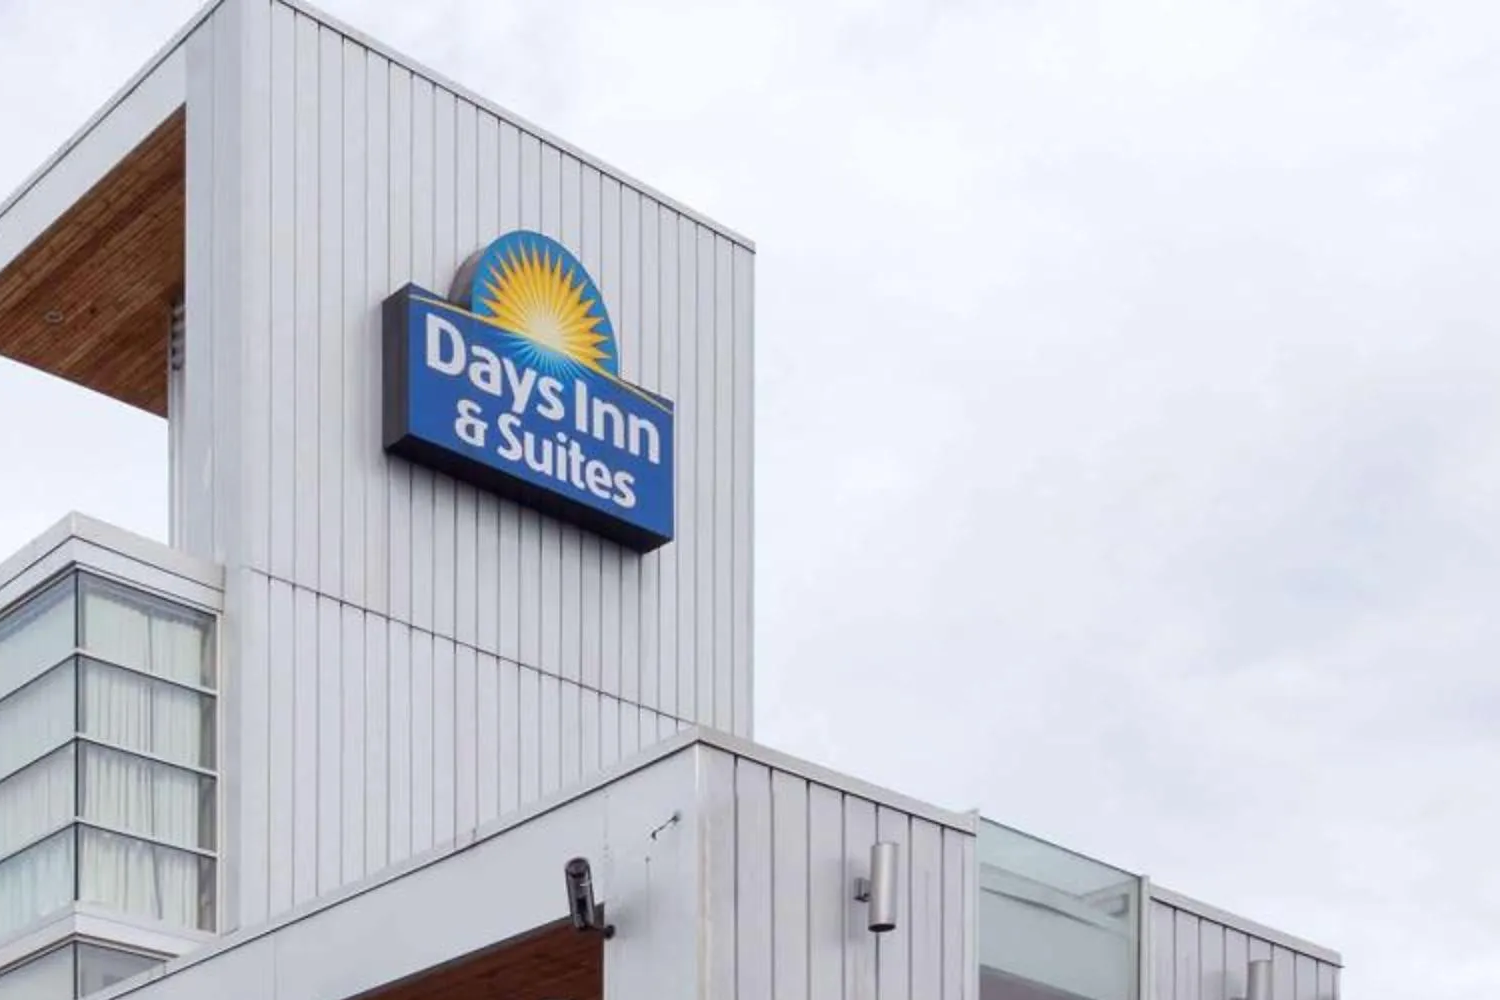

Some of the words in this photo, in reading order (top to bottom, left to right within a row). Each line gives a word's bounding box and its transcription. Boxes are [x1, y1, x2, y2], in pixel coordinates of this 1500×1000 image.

[426, 313, 564, 420] Days
[574, 379, 659, 463] Inn
[455, 399, 488, 446] &
[497, 413, 636, 507] Suites
